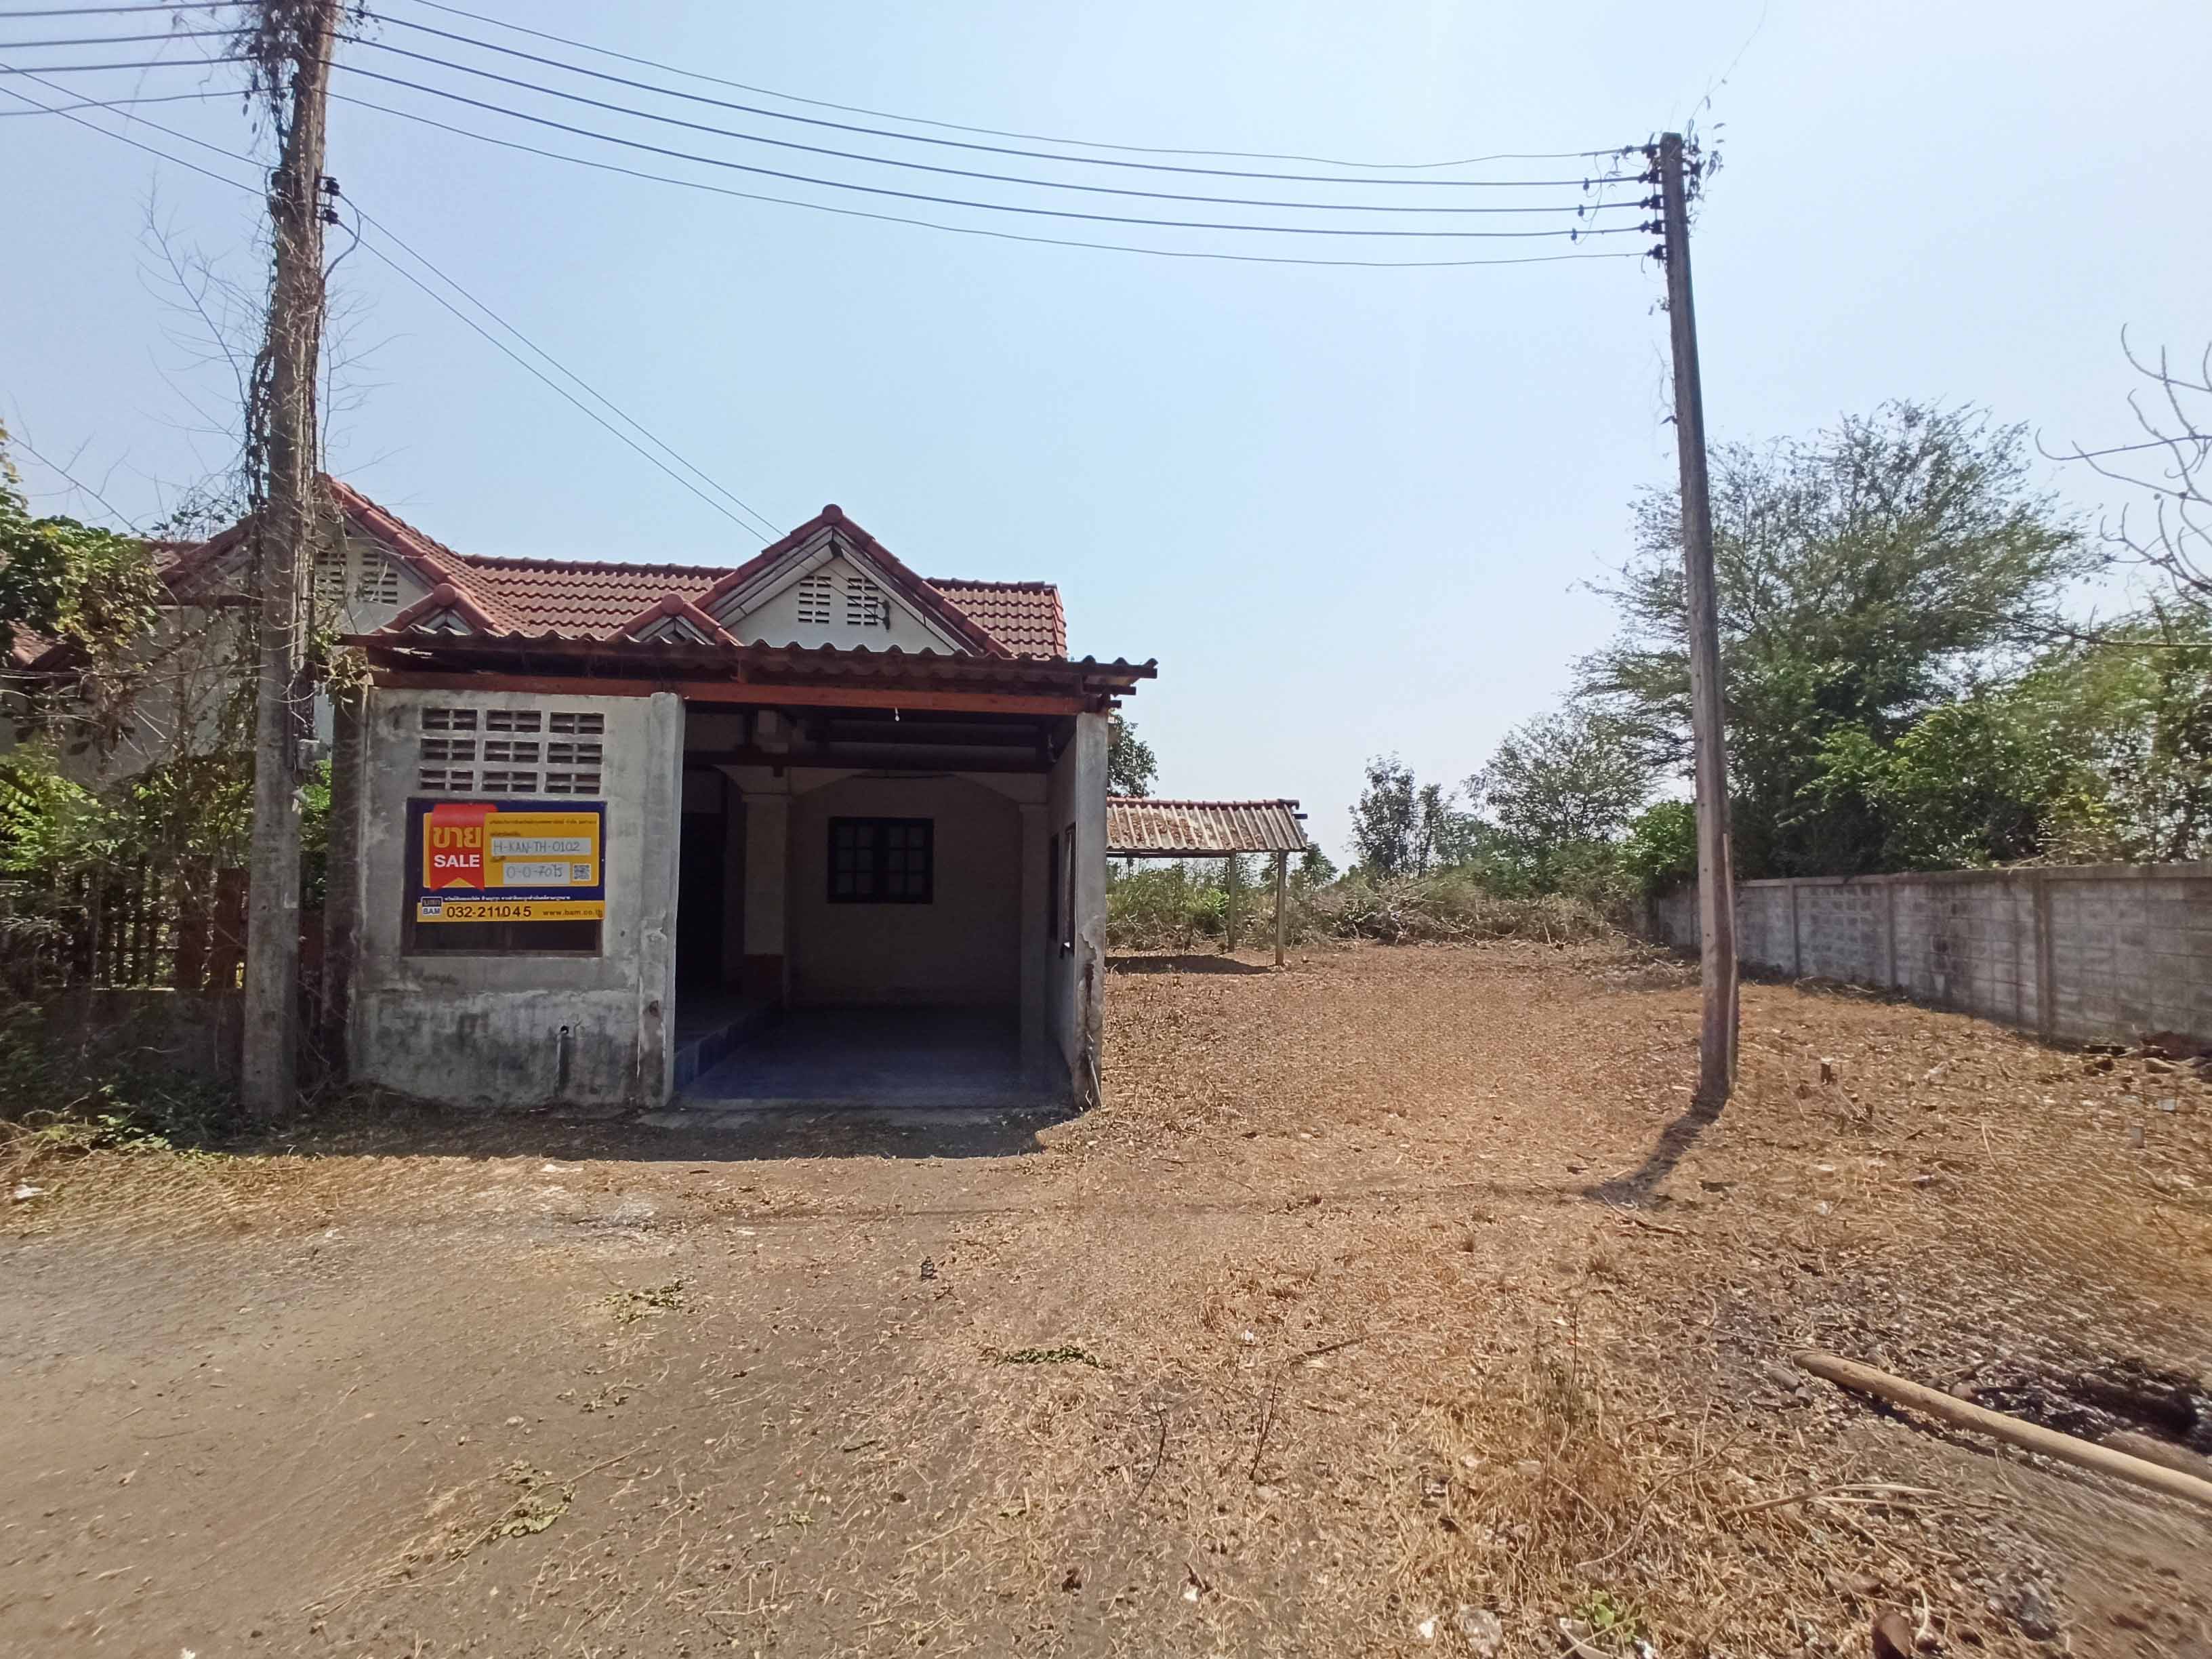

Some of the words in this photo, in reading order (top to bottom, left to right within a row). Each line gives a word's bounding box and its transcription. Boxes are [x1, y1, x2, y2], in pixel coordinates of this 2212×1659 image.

[434, 827, 481, 848] ขาย
[434, 855, 480, 867] SALE
[447, 906, 531, 918] 032-211045
